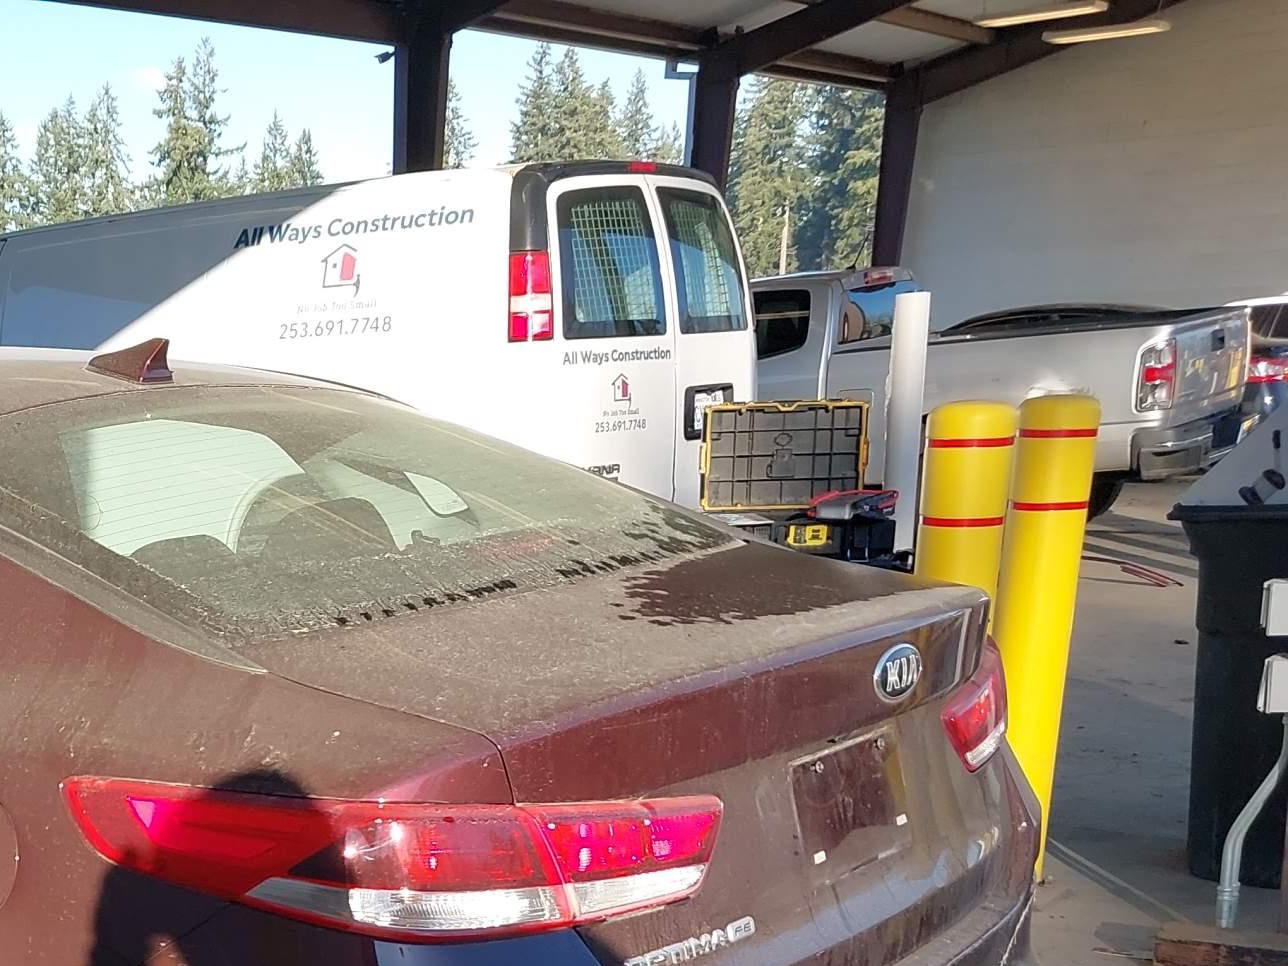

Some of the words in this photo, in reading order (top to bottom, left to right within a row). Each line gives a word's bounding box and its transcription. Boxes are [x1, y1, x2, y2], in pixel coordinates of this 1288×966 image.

[234, 225, 265, 249] All
[267, 222, 322, 244] Ways
[327, 205, 475, 237] Construction
[279, 316, 393, 340] 253.691.7748
[563, 351, 578, 365] All
[581, 350, 610, 366] Ways
[611, 346, 672, 362] Construction
[595, 418, 647, 433] 253.691.7748
[884, 653, 920, 693] KIA
[732, 919, 754, 940] FE
